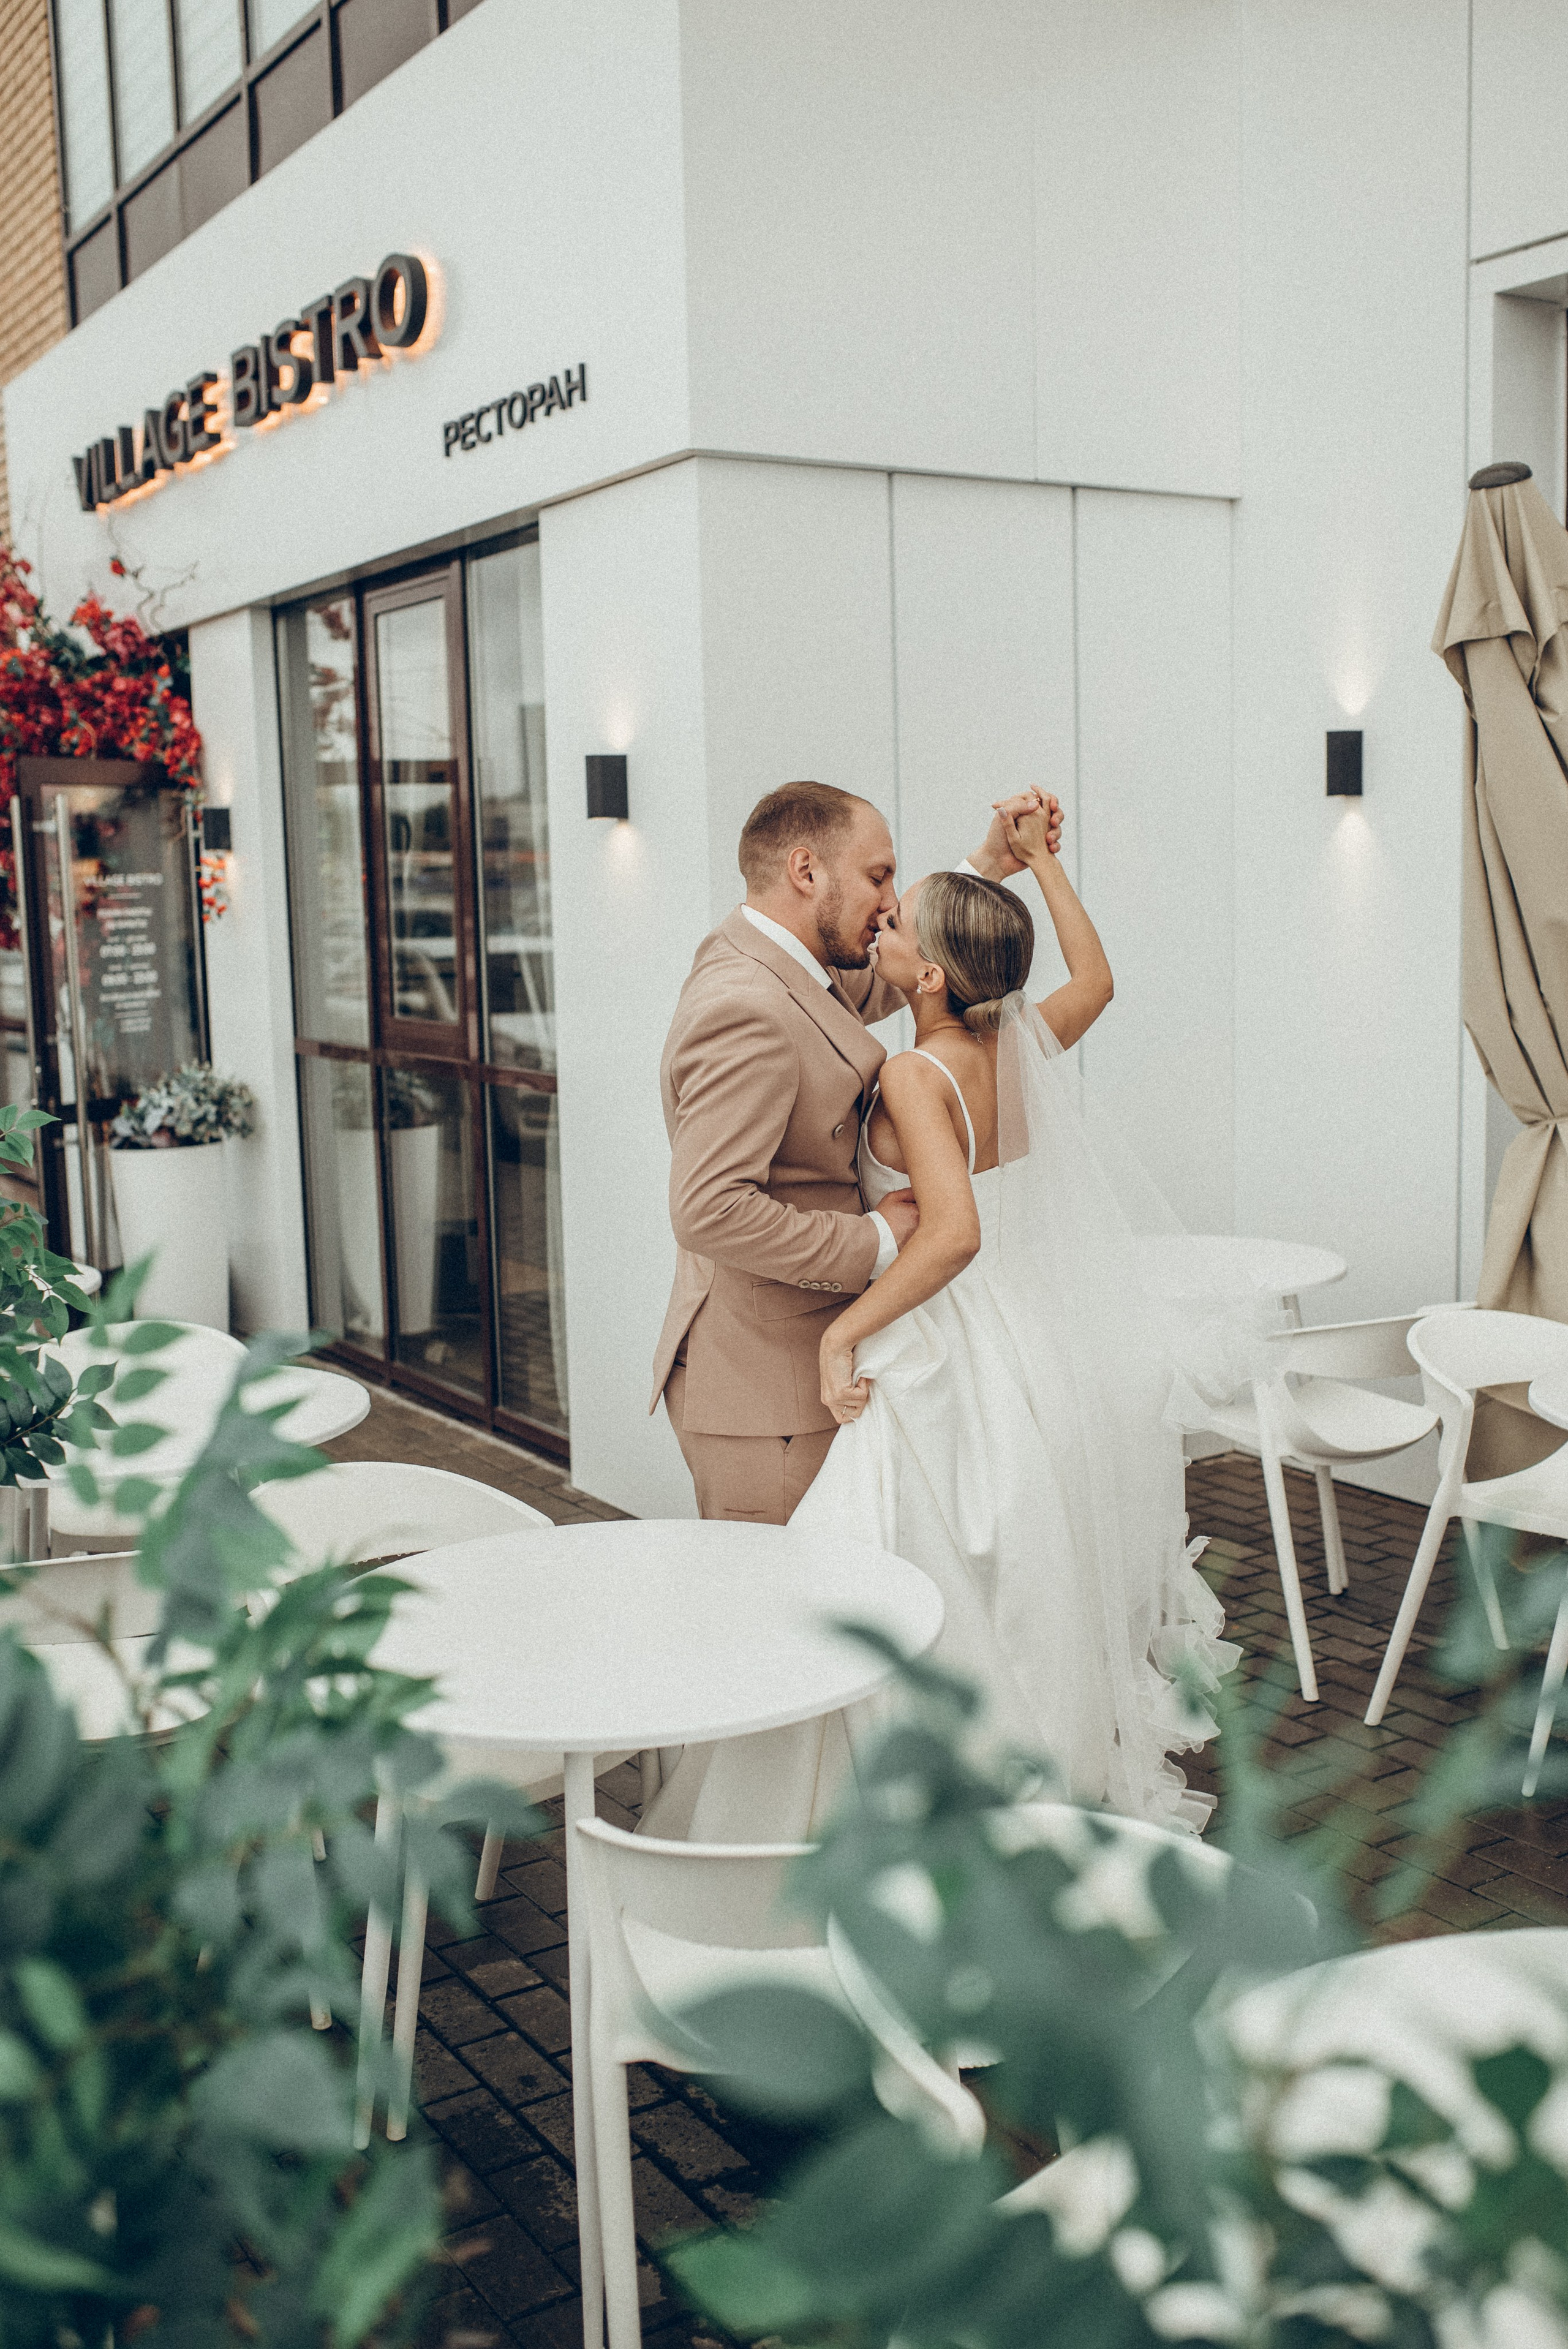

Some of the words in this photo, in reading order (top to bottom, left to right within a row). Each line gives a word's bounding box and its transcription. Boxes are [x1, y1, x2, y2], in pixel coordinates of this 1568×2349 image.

[72, 372, 221, 511] VILLAGE
[232, 253, 428, 427] BISTRO
[443, 363, 586, 457] РЕСТОРАН
